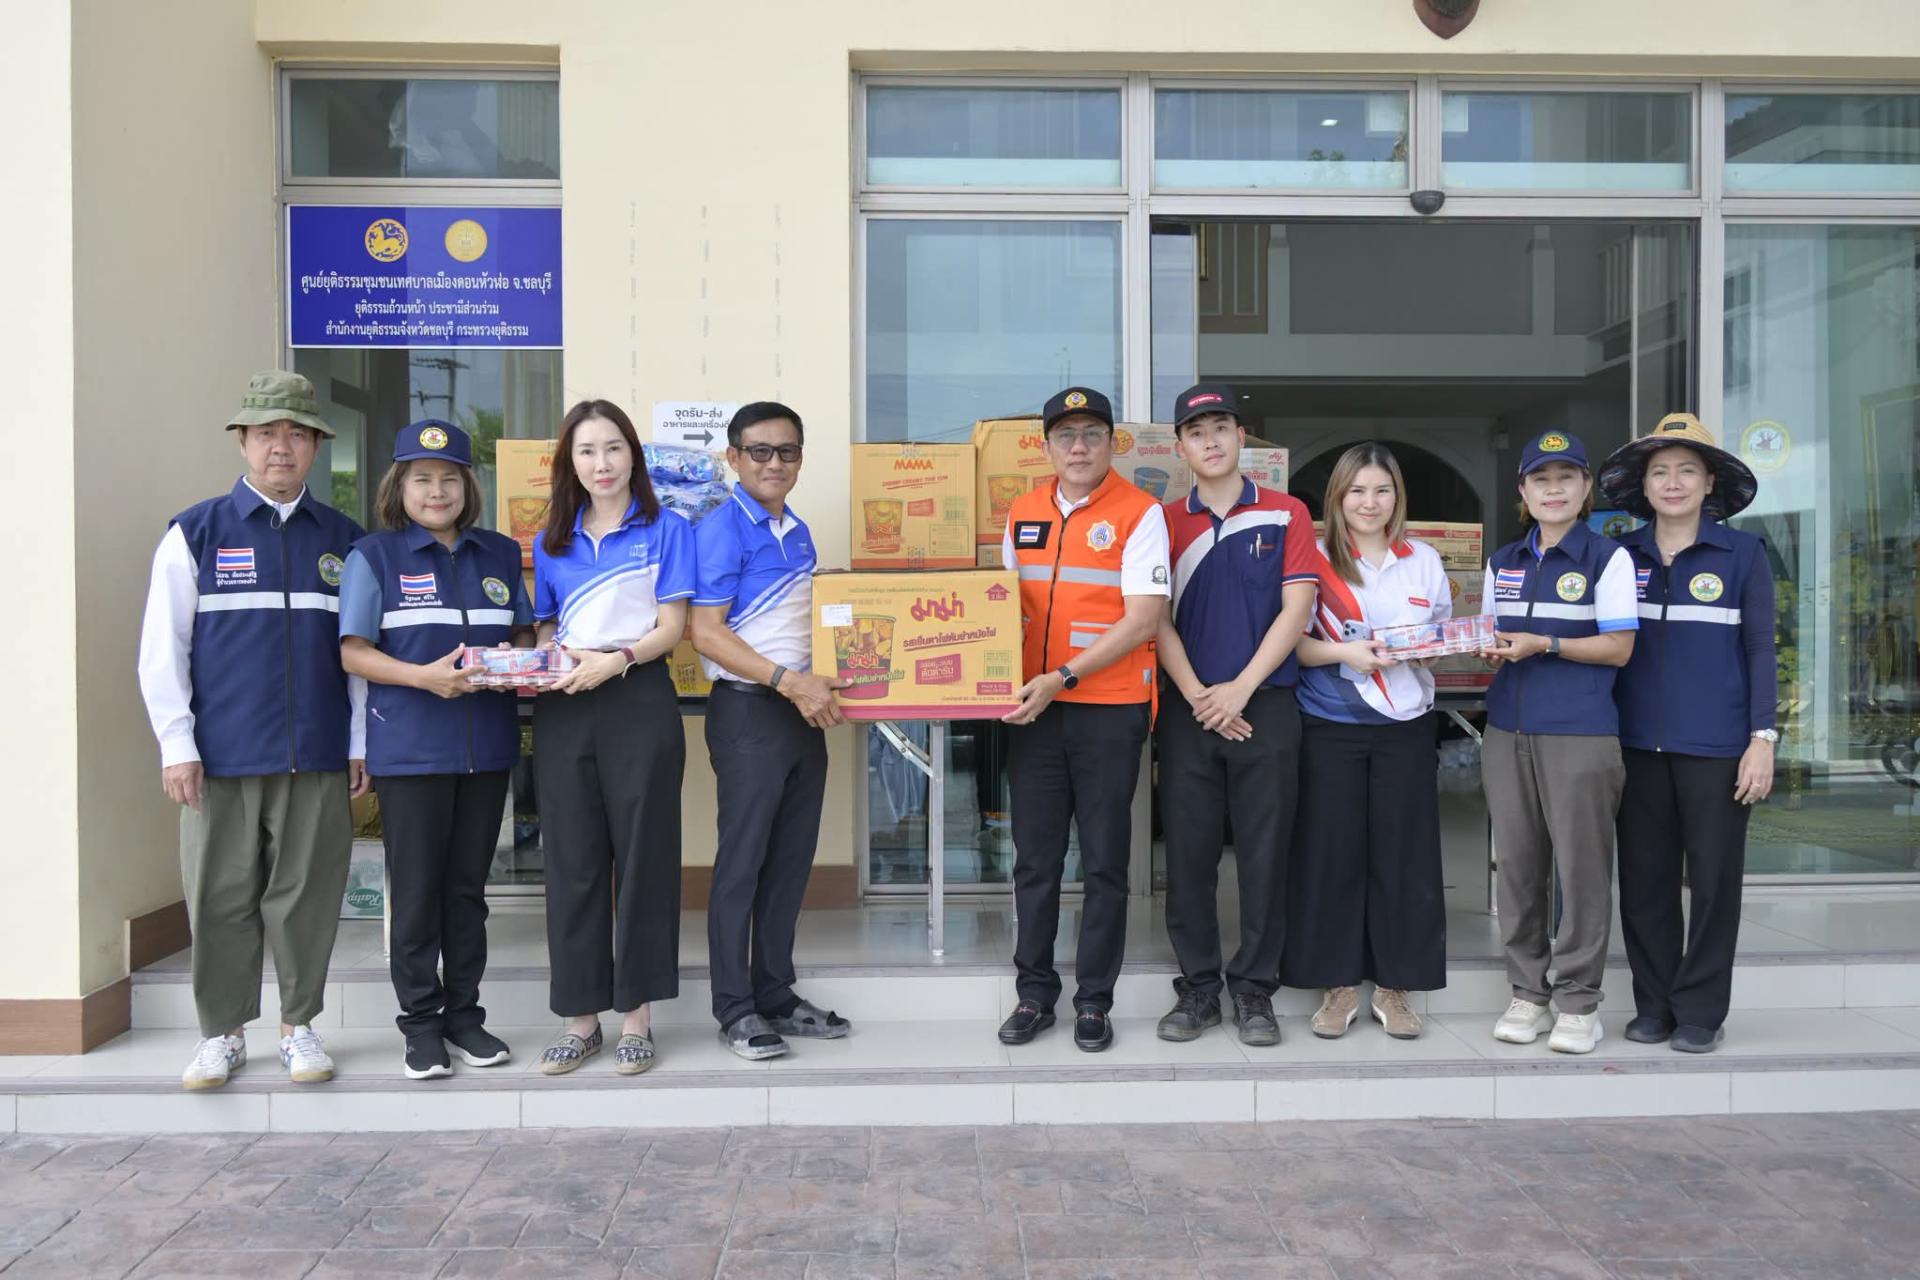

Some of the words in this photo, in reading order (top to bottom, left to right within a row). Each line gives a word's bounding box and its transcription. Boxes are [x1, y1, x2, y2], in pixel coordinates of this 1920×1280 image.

[513, 271, 552, 295] จ.ชลบุรี
[355, 298, 426, 319] ยุติธรรมถ้วนหน้า
[428, 298, 499, 316] ประชามีส่วนร่วม
[325, 319, 454, 341] สำนักงานยุติธรรมจังหวัดชลบุรี
[456, 320, 529, 341] กระทรวงยุติธรรม
[674, 406, 723, 420] จุดรับ-ส่ง
[894, 459, 934, 470] MAMA
[910, 591, 965, 622] มาม่า
